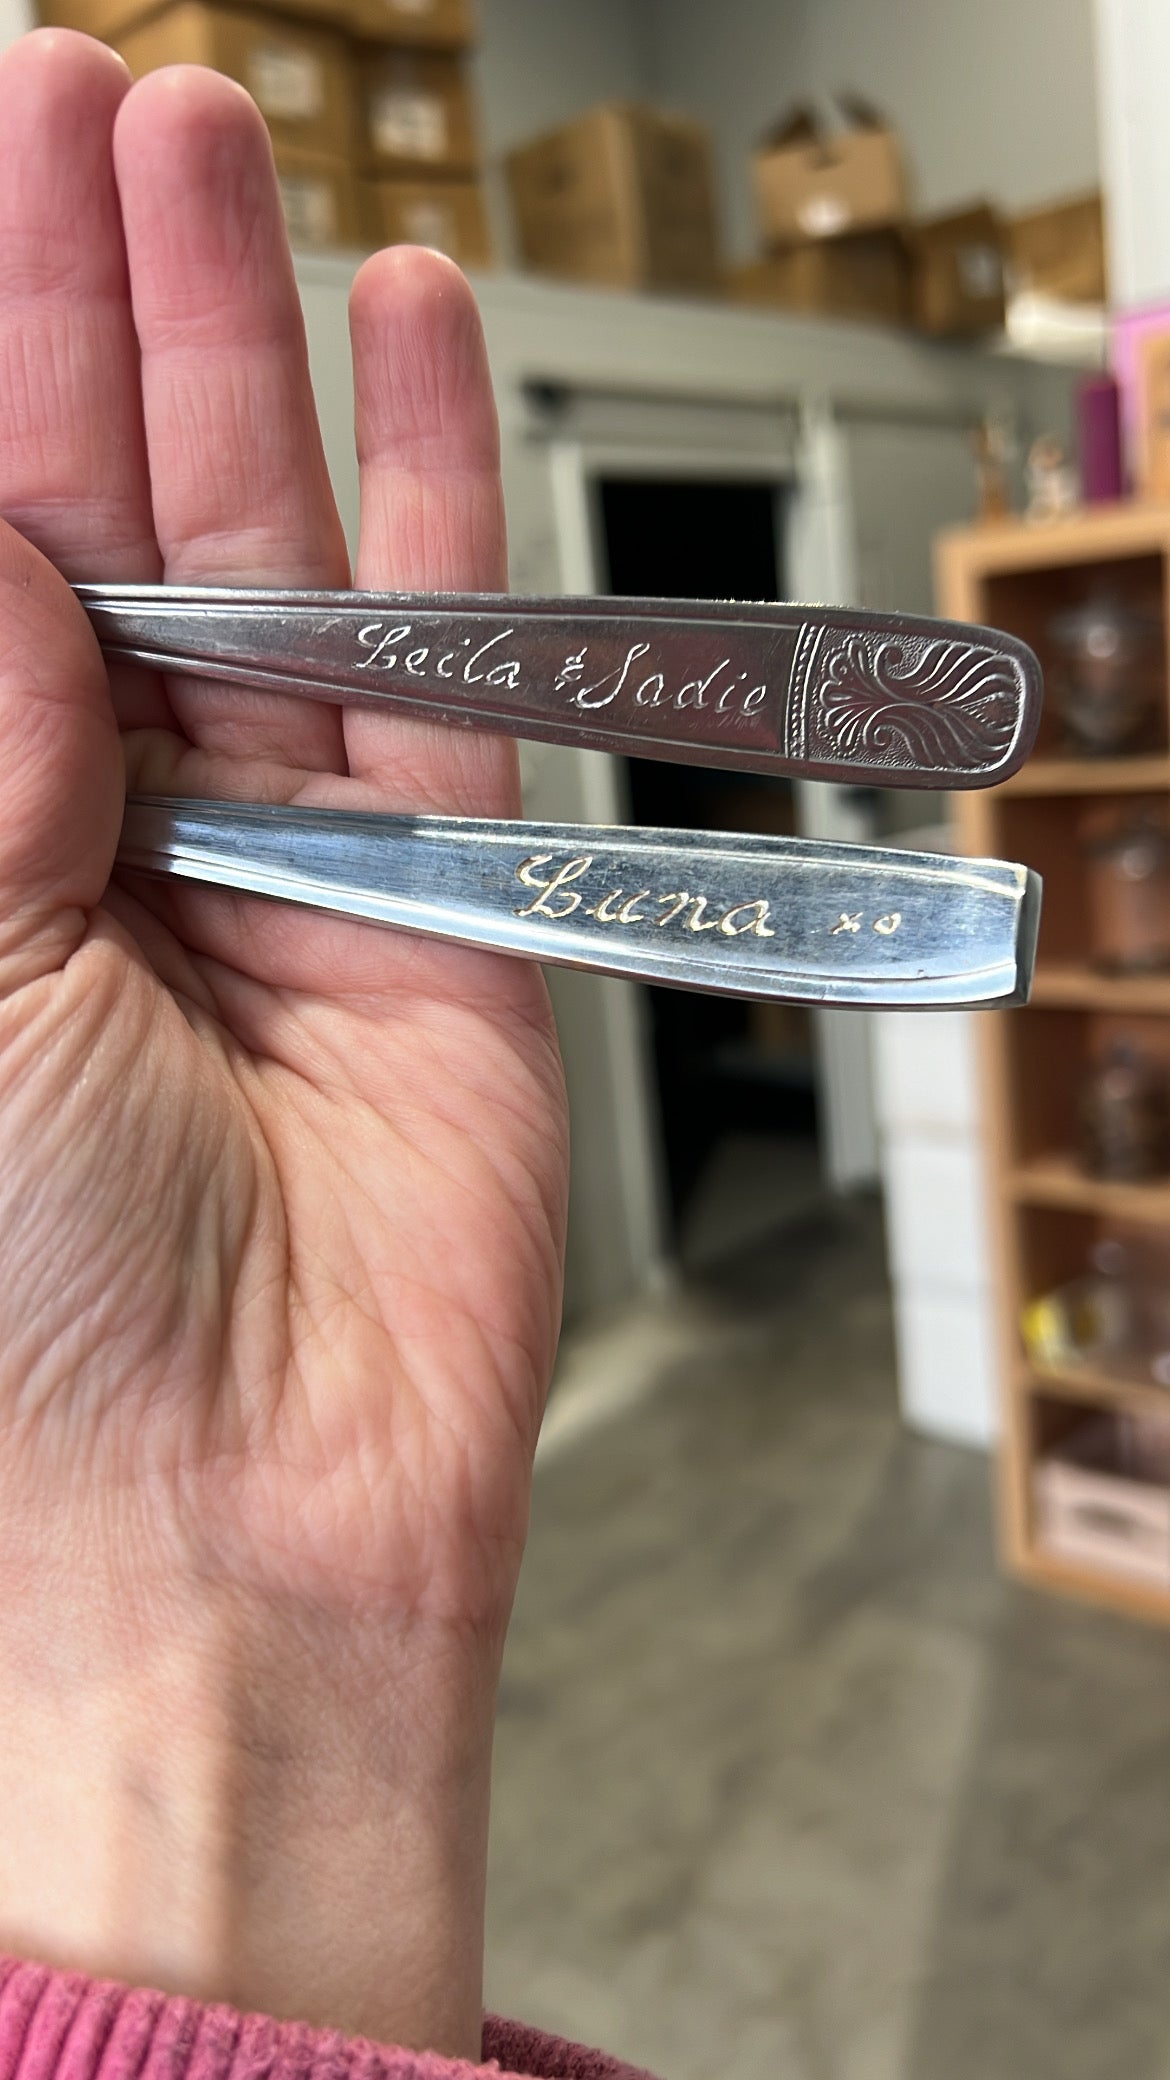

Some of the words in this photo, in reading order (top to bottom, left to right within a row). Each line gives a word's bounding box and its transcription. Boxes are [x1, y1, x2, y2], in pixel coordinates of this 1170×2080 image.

[353, 622, 522, 691] Leila
[554, 646, 589, 692] &
[569, 642, 768, 717] Sadie
[512, 854, 776, 937] Luna
